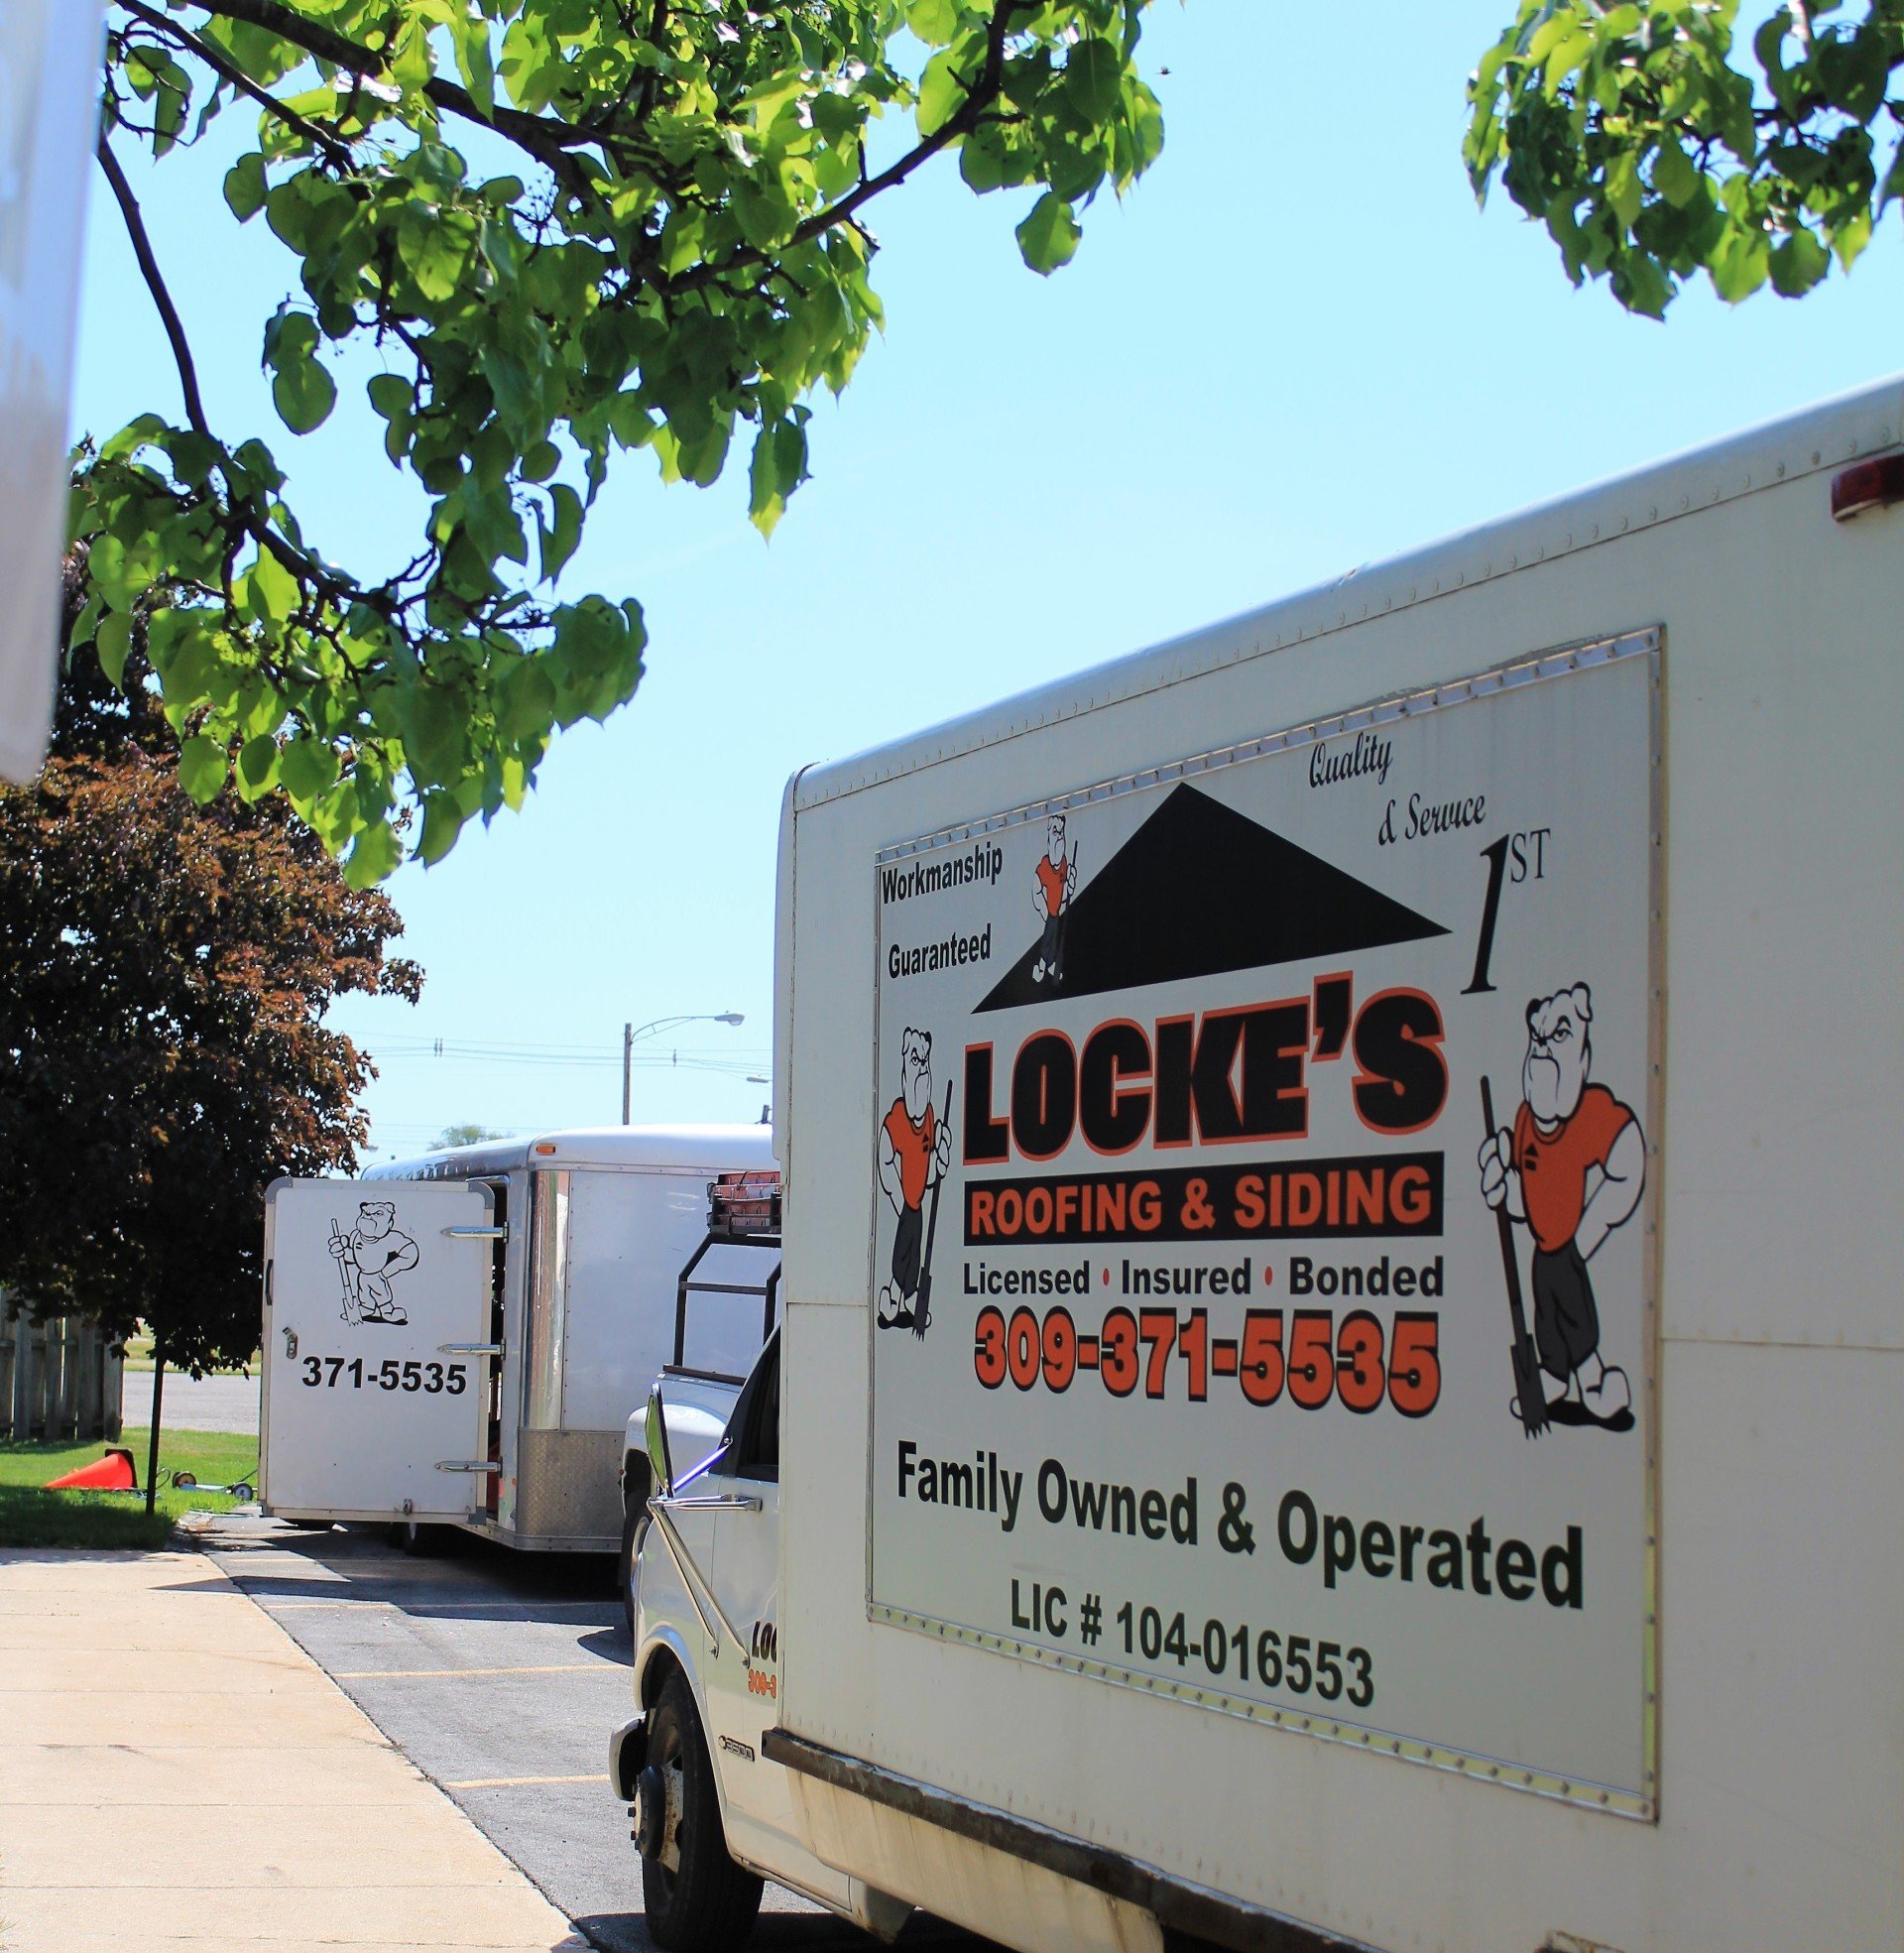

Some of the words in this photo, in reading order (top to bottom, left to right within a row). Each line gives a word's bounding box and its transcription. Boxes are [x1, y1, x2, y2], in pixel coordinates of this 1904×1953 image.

[1308, 731, 1393, 788] Quality
[1404, 793, 1487, 840] Service
[882, 841, 1004, 904] Workmanship
[889, 922, 992, 979] Guaranteed
[963, 970, 1450, 1166] LOCKE'S
[971, 1180, 1162, 1236] ROOFING
[1180, 1177, 1216, 1231] &
[1234, 1165, 1432, 1229] SIDING
[964, 1260, 1090, 1294] Licensed
[1122, 1257, 1252, 1294] Insured
[1289, 1255, 1444, 1297] Bonded
[301, 1356, 467, 1396] 371-5535
[974, 1305, 1441, 1418] 309-371-5535
[897, 1440, 1022, 1532] Family
[1037, 1458, 1198, 1545] Owned
[1217, 1481, 1256, 1556] &
[1277, 1489, 1584, 1610] Operated
[1010, 1578, 1068, 1637] LIC
[1080, 1592, 1103, 1646] #
[1117, 1601, 1374, 1708] 104-016553
